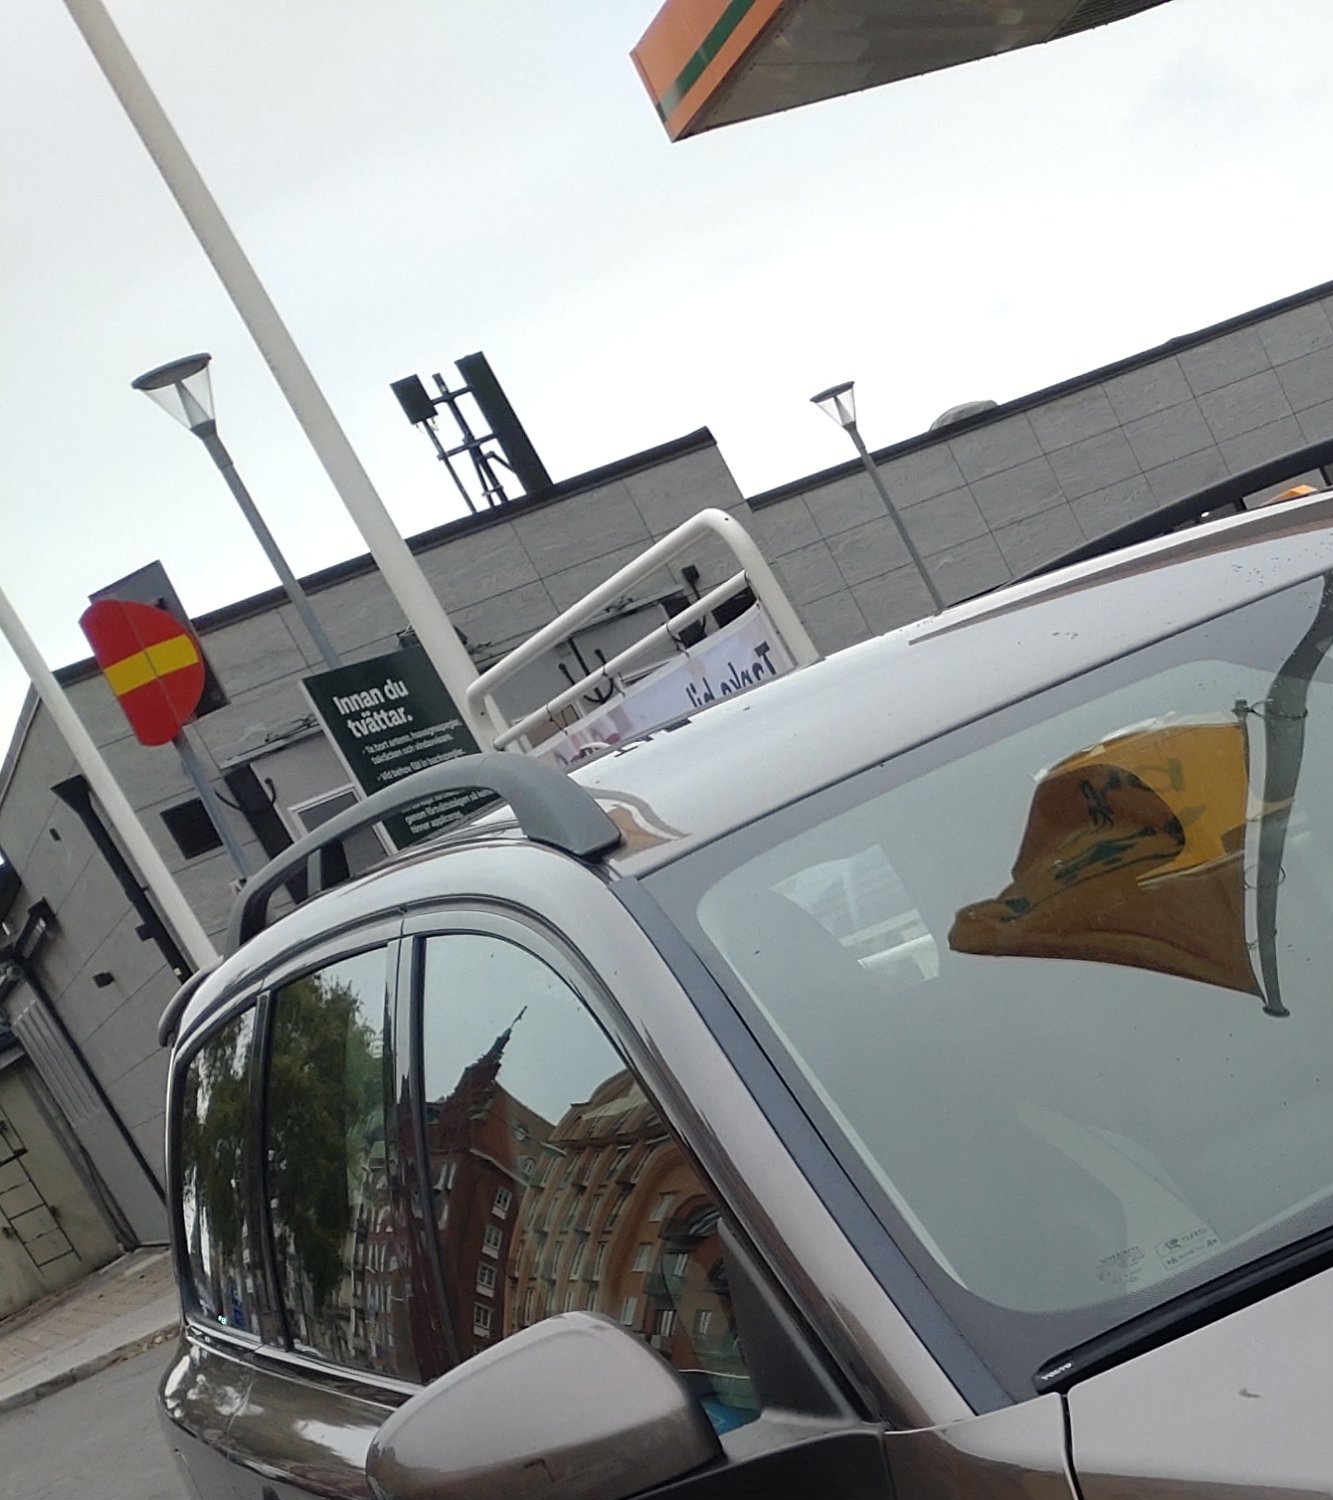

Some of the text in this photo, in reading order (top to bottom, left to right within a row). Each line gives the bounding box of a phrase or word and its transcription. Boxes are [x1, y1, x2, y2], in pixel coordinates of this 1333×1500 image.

[332, 678, 410, 715] Innan du
[347, 706, 413, 739] tvättar.
